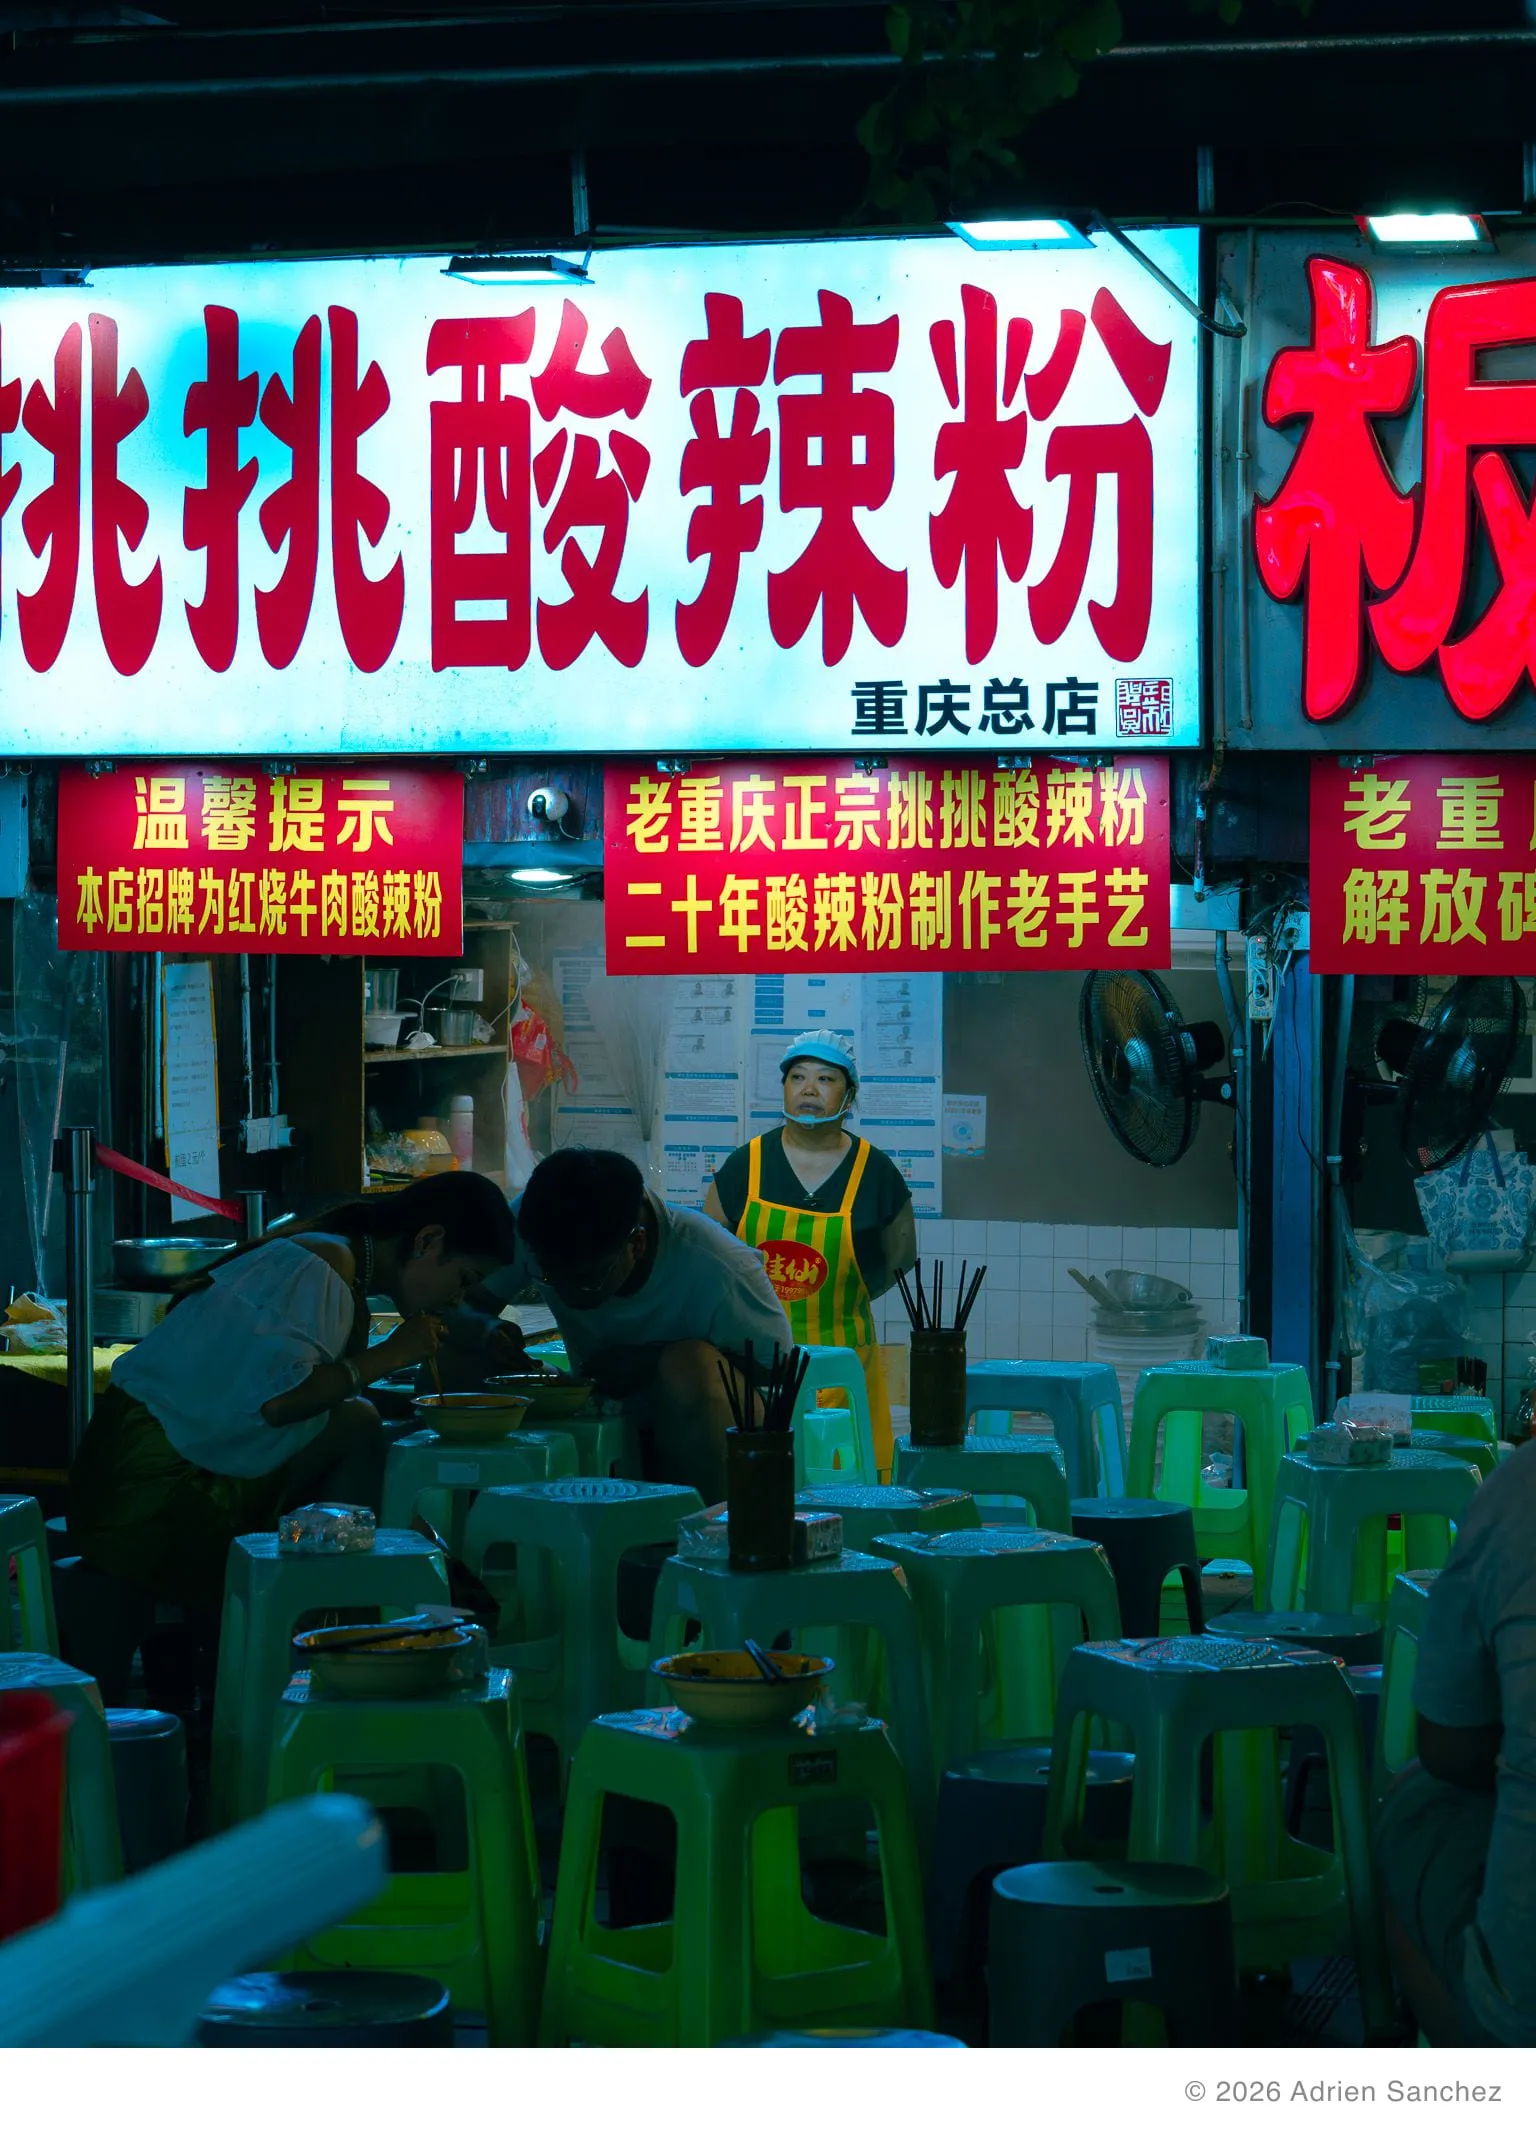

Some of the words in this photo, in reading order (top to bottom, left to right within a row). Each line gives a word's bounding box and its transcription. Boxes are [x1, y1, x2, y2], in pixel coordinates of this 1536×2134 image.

[851, 677, 1099, 736] 重庆总店
[132, 775, 394, 852] 温馨提示
[626, 768, 1147, 853] 老重庆正宗挑挑酸辣粉
[1343, 775, 1536, 851] 老重
[76, 866, 441, 939] 本店招牌为红烧牛肉酸辣粉
[625, 867, 1149, 953] 二十年酸辣粉制作老手艺
